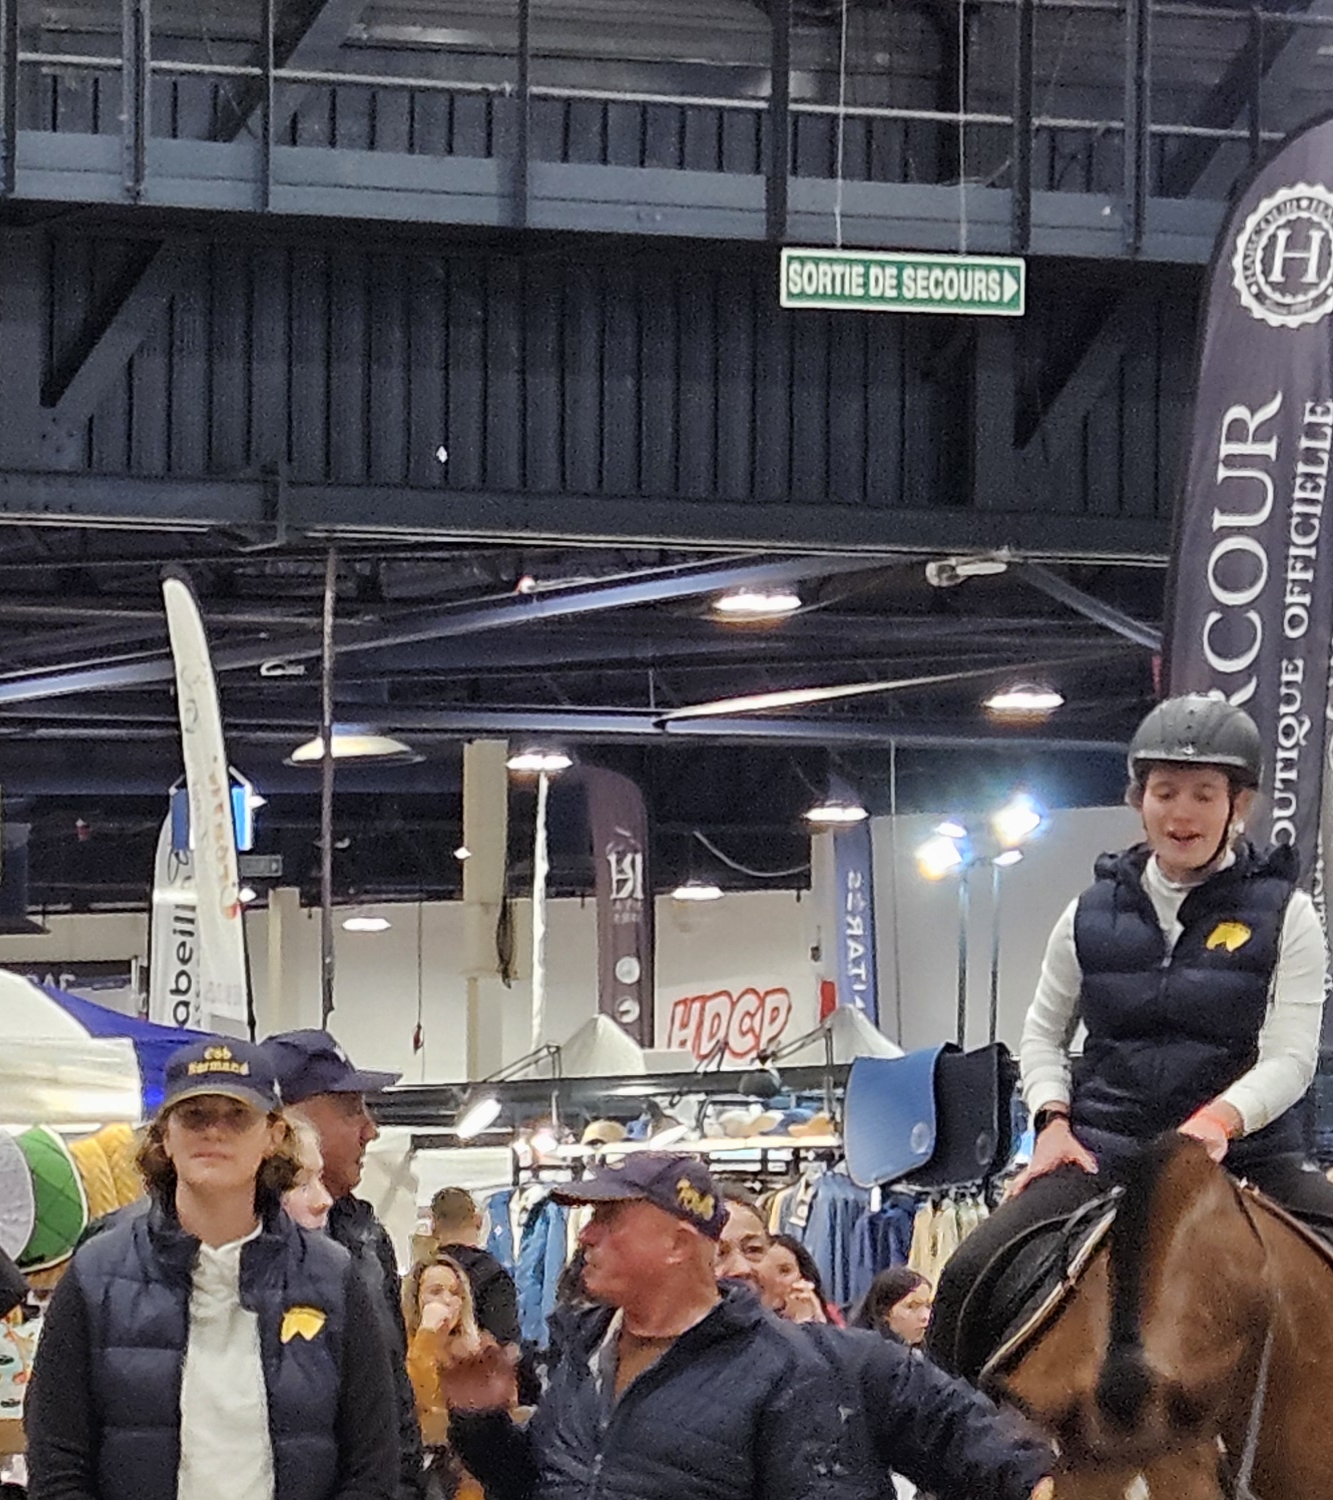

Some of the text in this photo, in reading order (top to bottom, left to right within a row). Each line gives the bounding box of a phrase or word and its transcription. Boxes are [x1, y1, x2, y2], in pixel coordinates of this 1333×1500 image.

[788, 260, 1001, 302] SORTIE DE SECOURS
[1268, 228, 1325, 283] H
[1270, 400, 1333, 848] OUTIQUE OFFICIELLE
